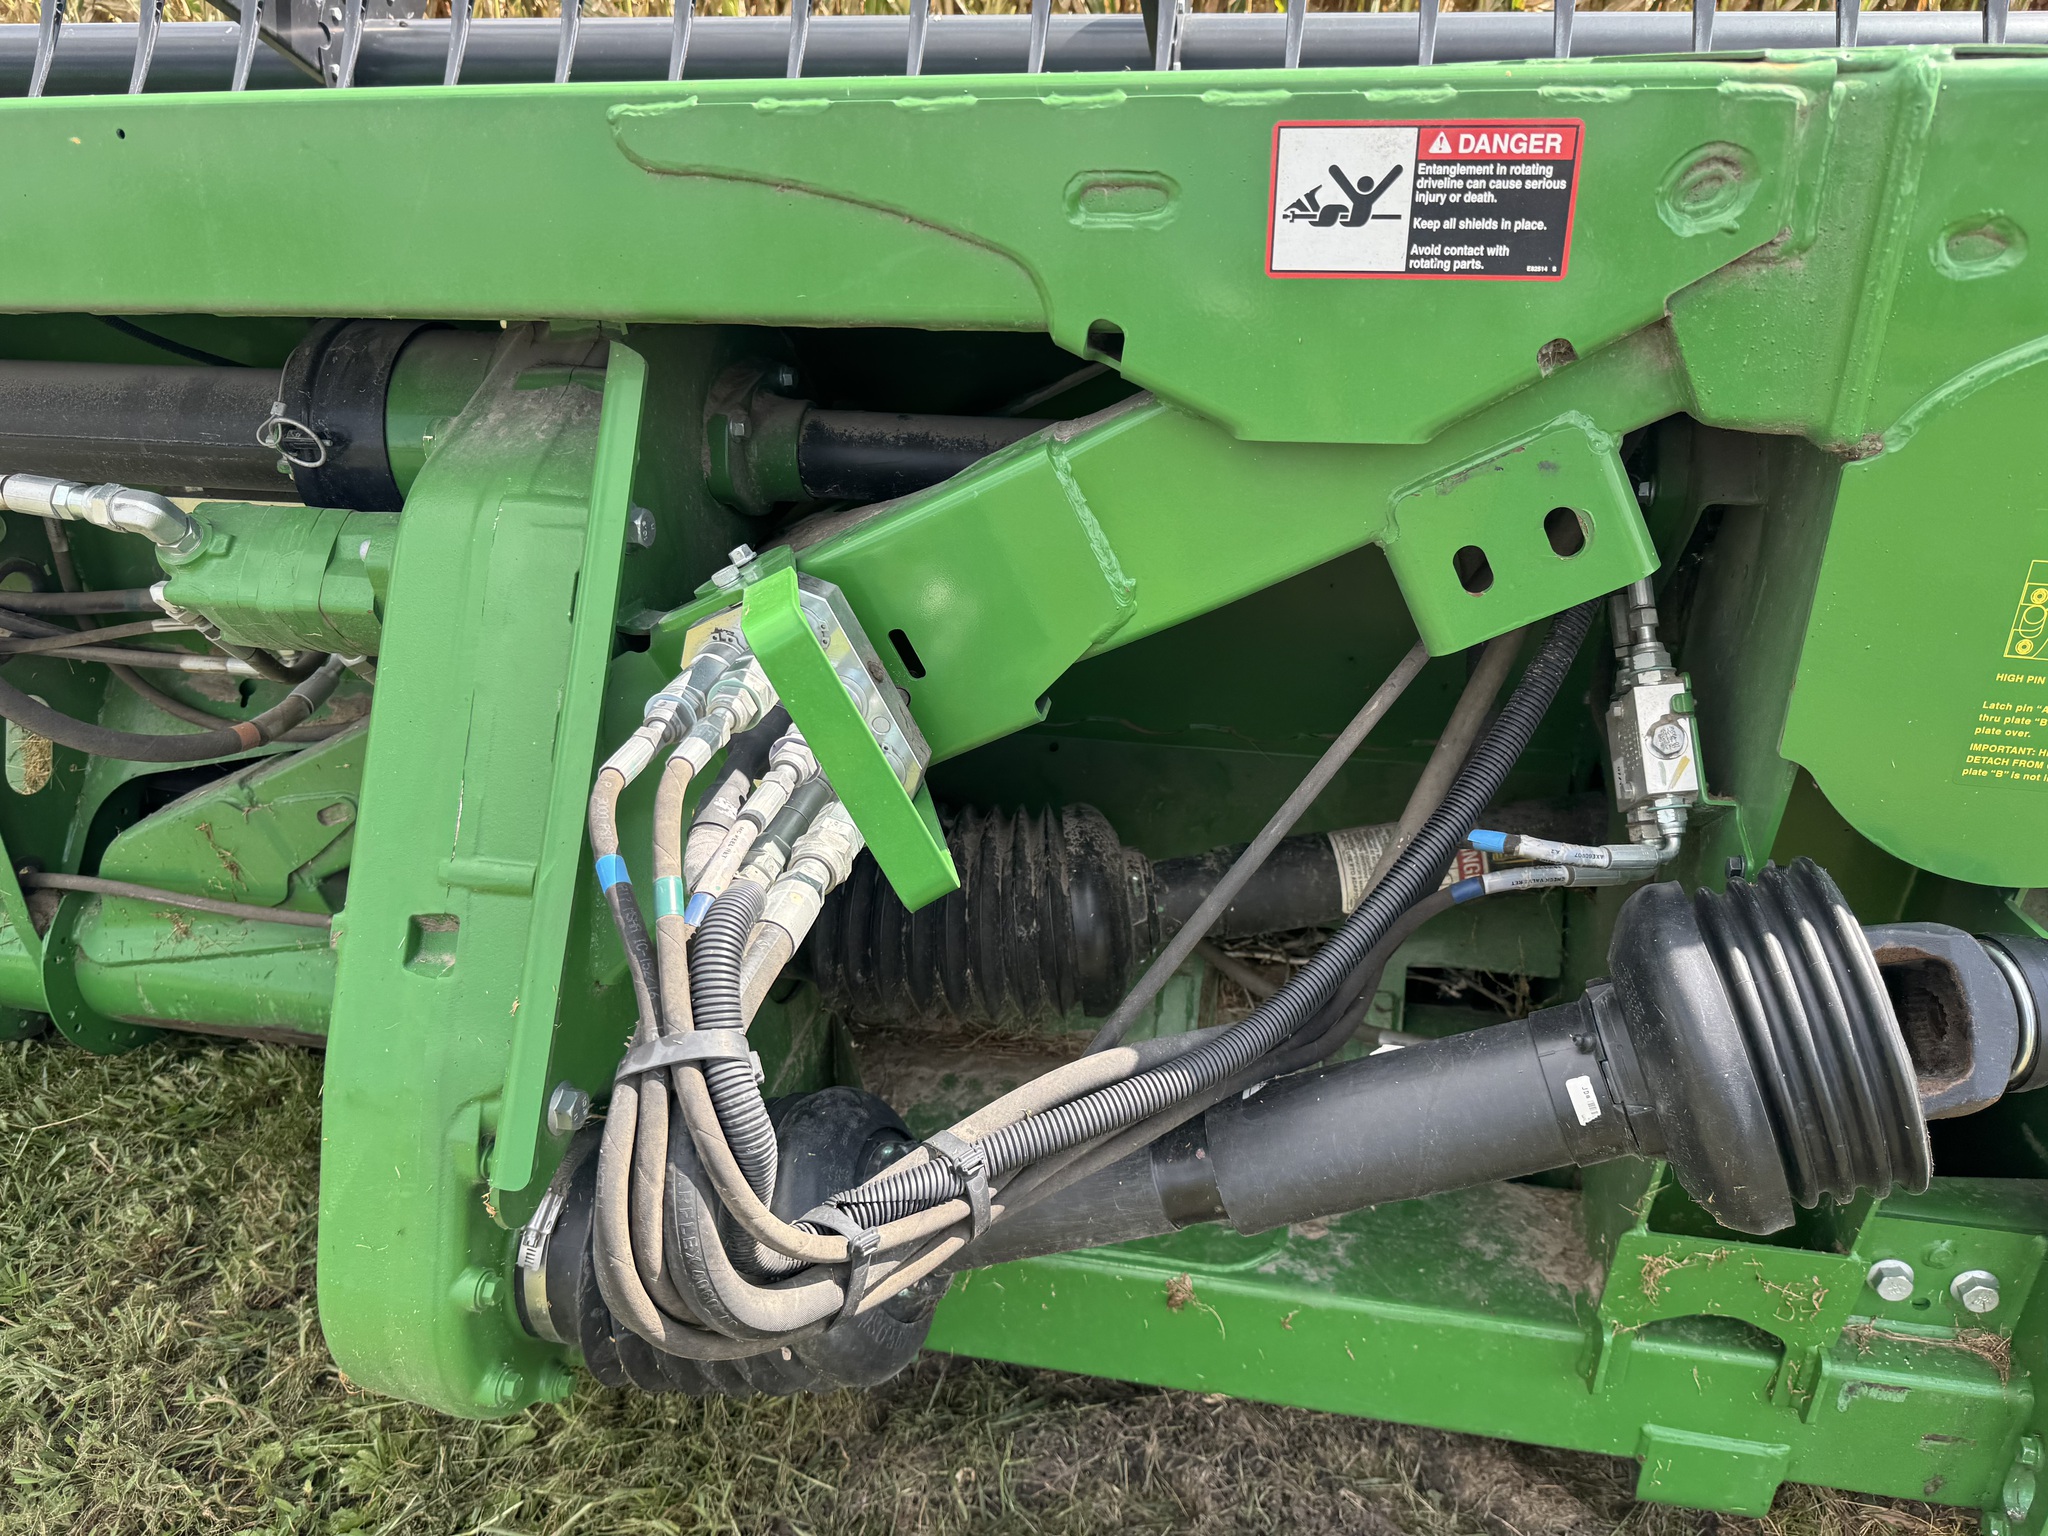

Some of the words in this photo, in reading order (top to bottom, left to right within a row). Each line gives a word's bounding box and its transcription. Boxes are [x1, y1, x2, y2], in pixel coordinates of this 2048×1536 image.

[1458, 133, 1563, 154] DANGER
[1417, 163, 1494, 178] Entanglement
[1496, 164, 1507, 175] in
[1510, 164, 1553, 178] rotating
[1416, 177, 1464, 189] driveline
[1466, 180, 1487, 189] can
[1488, 180, 1523, 190] cause
[1524, 178, 1567, 190] serious
[1415, 192, 1447, 205] injury
[1449, 194, 1461, 203] or
[1463, 192, 1497, 203] death.
[1413, 218, 1441, 232] Keep
[1443, 218, 1457, 230] all
[1459, 219, 1498, 230] shields
[1500, 219, 1512, 231] in
[1514, 219, 1547, 233] place.
[1410, 244, 1441, 257] Avoid
[1443, 246, 1484, 257] contact
[1486, 246, 1510, 257] with
[1409, 257, 1451, 271] rotating
[1453, 258, 1484, 270] parts.
[1996, 673, 2024, 684] HIGH
[2026, 675, 2046, 685] PIN
[1983, 700, 2013, 711] Latch
[2015, 703, 2034, 713] pin
[1978, 713, 2001, 723] thru
[2003, 715, 2032, 726] plate
[1974, 726, 2002, 737] plate
[2005, 729, 2031, 738] over.
[1969, 743, 2036, 756] IMPORTANT:
[1966, 755, 2010, 766] DETACH
[2011, 759, 2044, 769] FROM
[1961, 767, 1989, 777] plate
[2010, 771, 2021, 780] is
[2022, 773, 2041, 782] not
